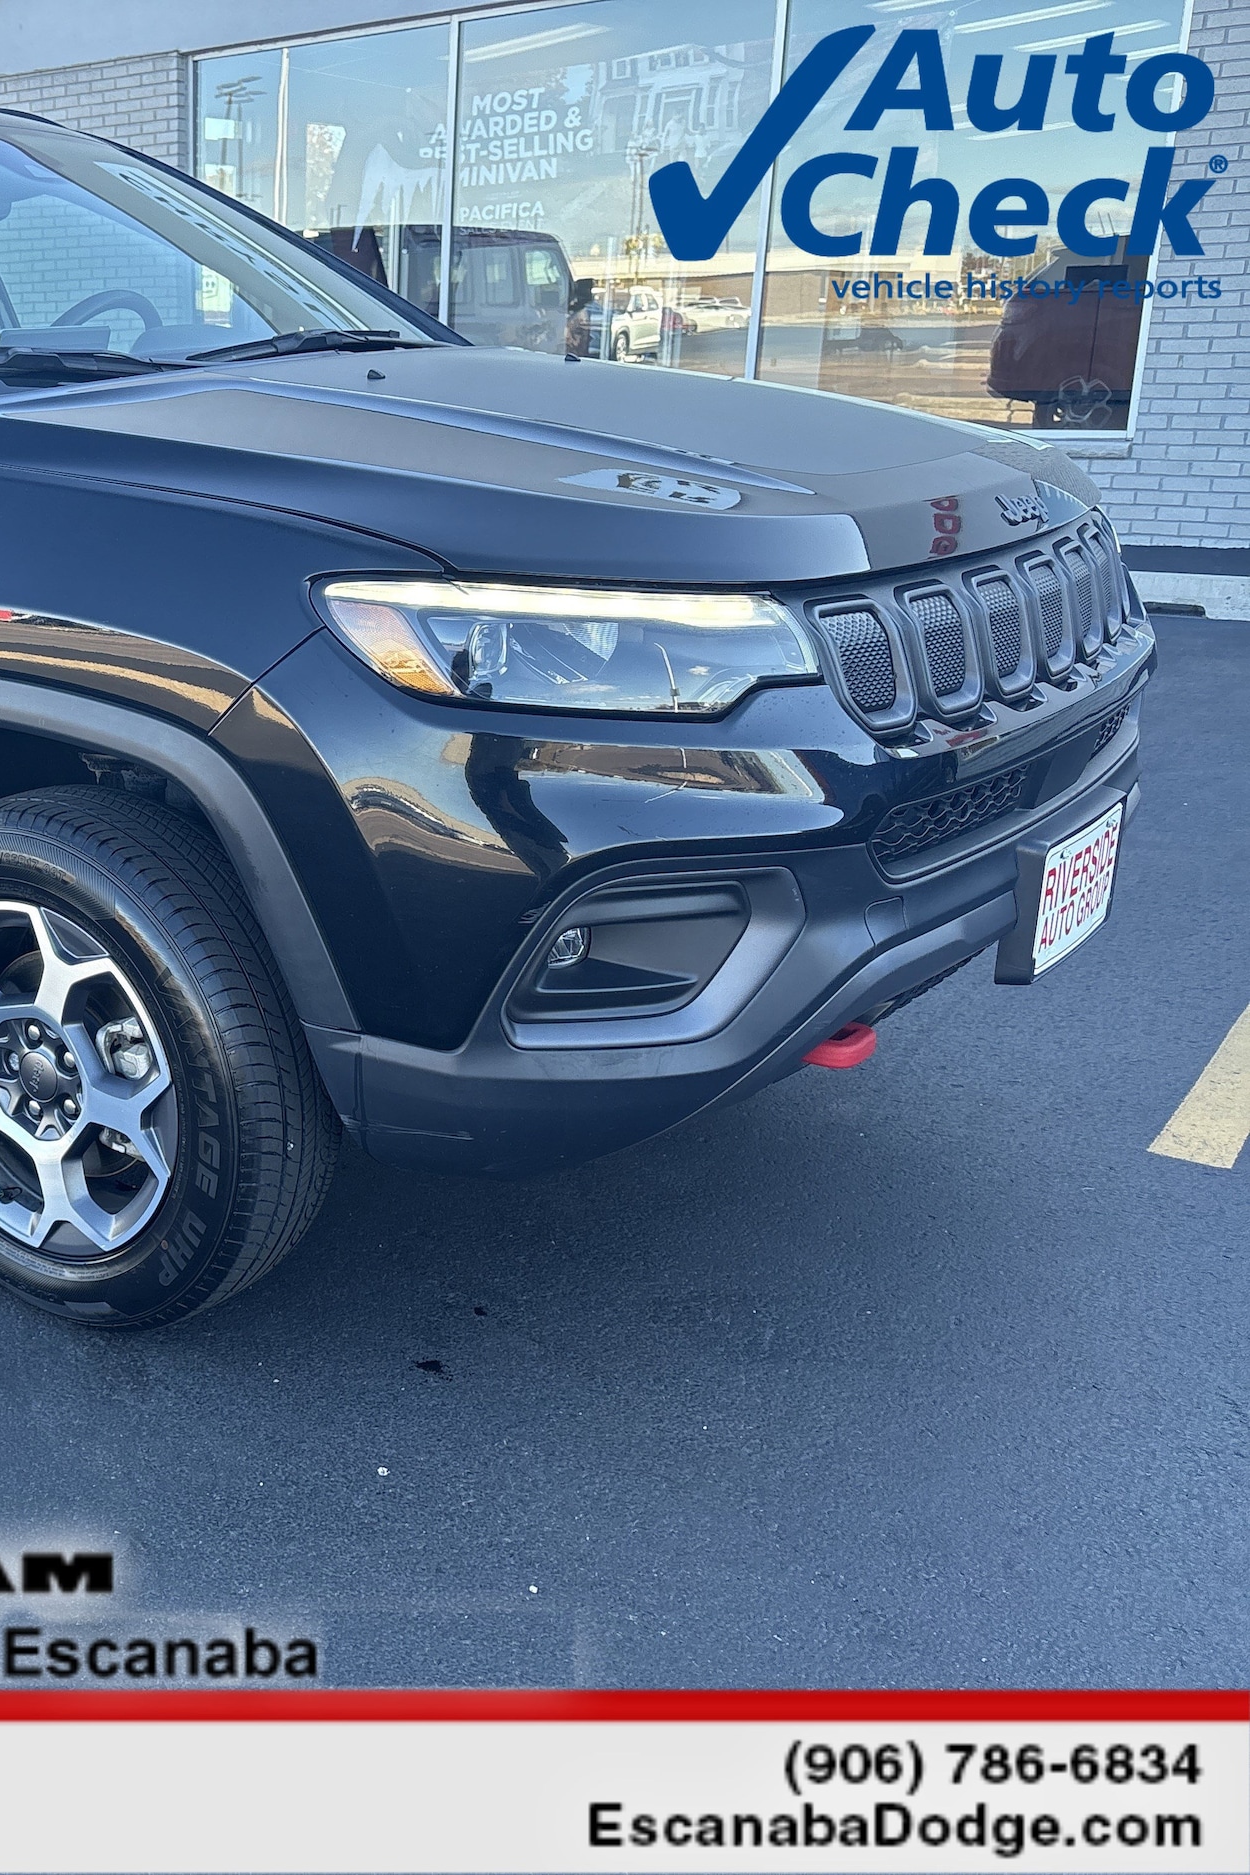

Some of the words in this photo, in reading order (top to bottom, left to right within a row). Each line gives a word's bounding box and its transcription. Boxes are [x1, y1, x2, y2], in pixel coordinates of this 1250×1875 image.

[471, 87, 546, 116] MOST
[563, 106, 582, 128] &
[459, 201, 545, 222] PACIFICA
[994, 493, 1050, 526] Jeep
[1041, 825, 1119, 916] RIVERSIDE
[1037, 899, 1075, 954] AUTO
[1075, 870, 1110, 929] GROUP
[157, 1210, 208, 1287] UHP
